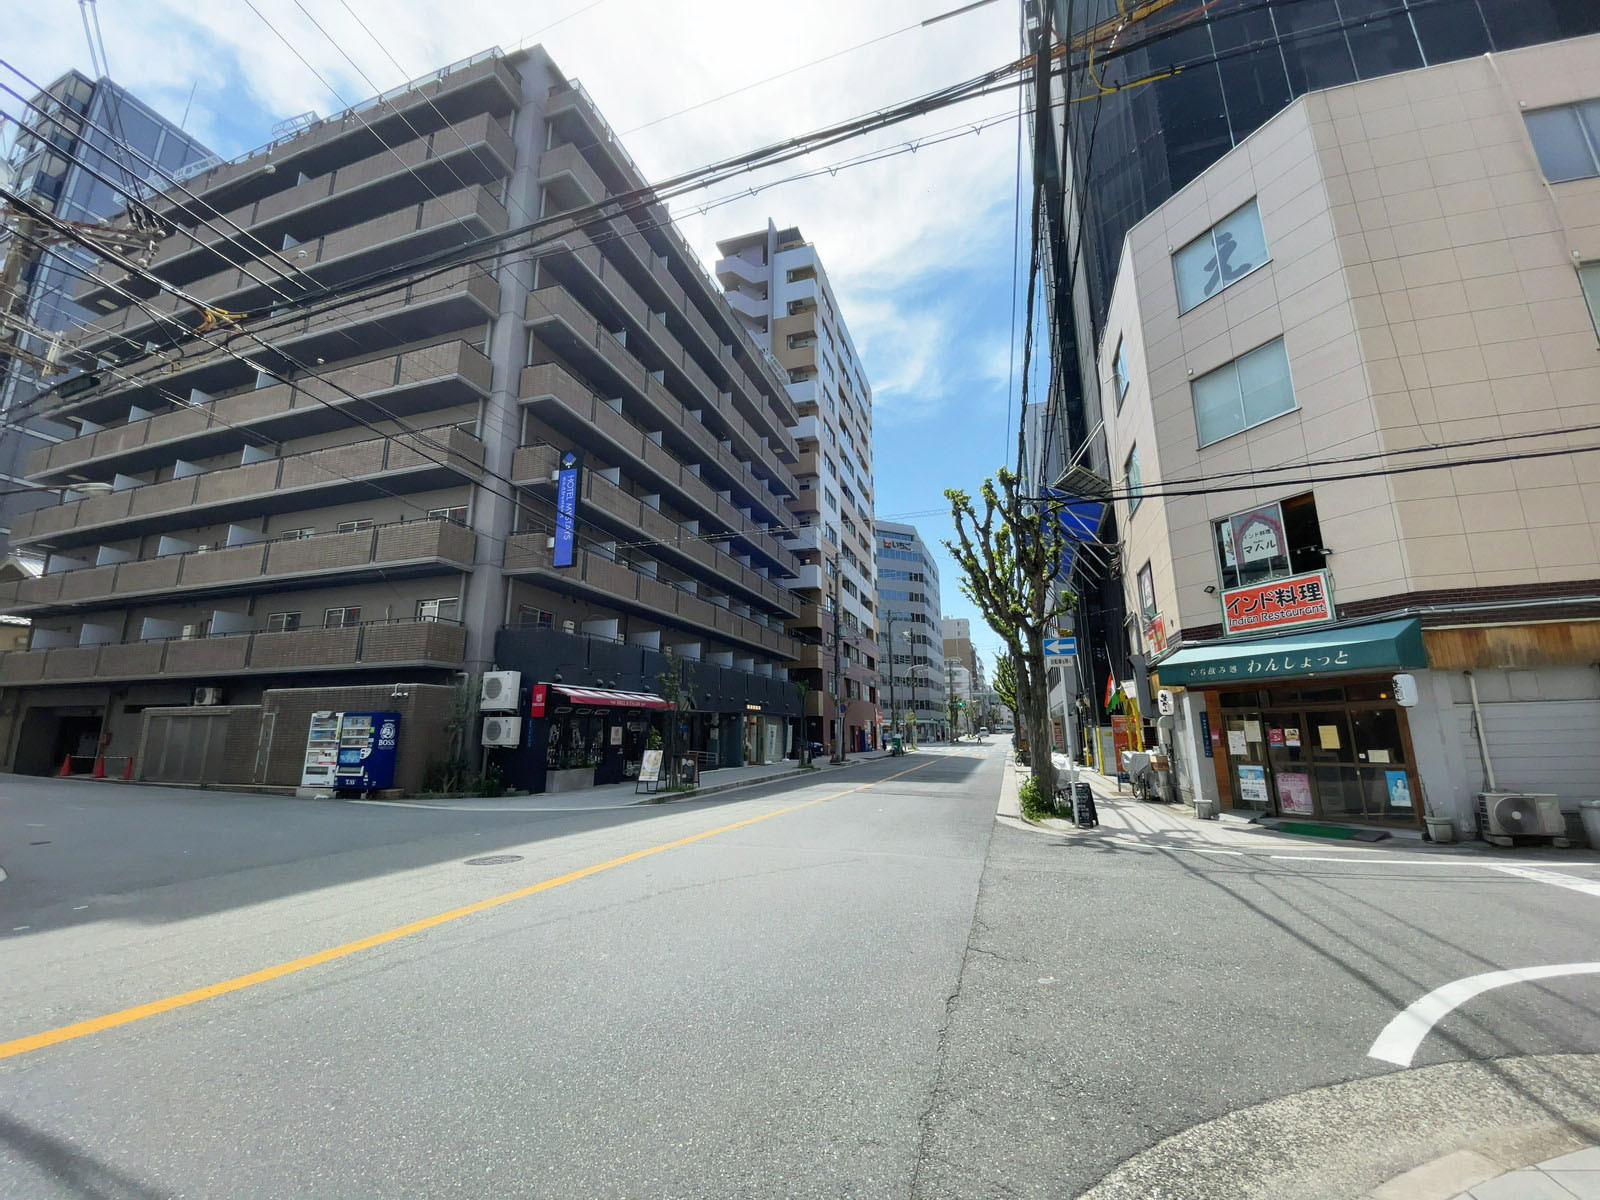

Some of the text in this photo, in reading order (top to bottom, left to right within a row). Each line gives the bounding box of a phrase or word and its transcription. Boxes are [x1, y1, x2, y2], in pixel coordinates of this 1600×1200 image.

[566, 474, 575, 500] HOTEL
[1243, 539, 1276, 554] マハル
[1227, 581, 1323, 615] インド料理
[1229, 603, 1326, 627] Indian Restaurant
[1247, 650, 1349, 673] わんしょっと
